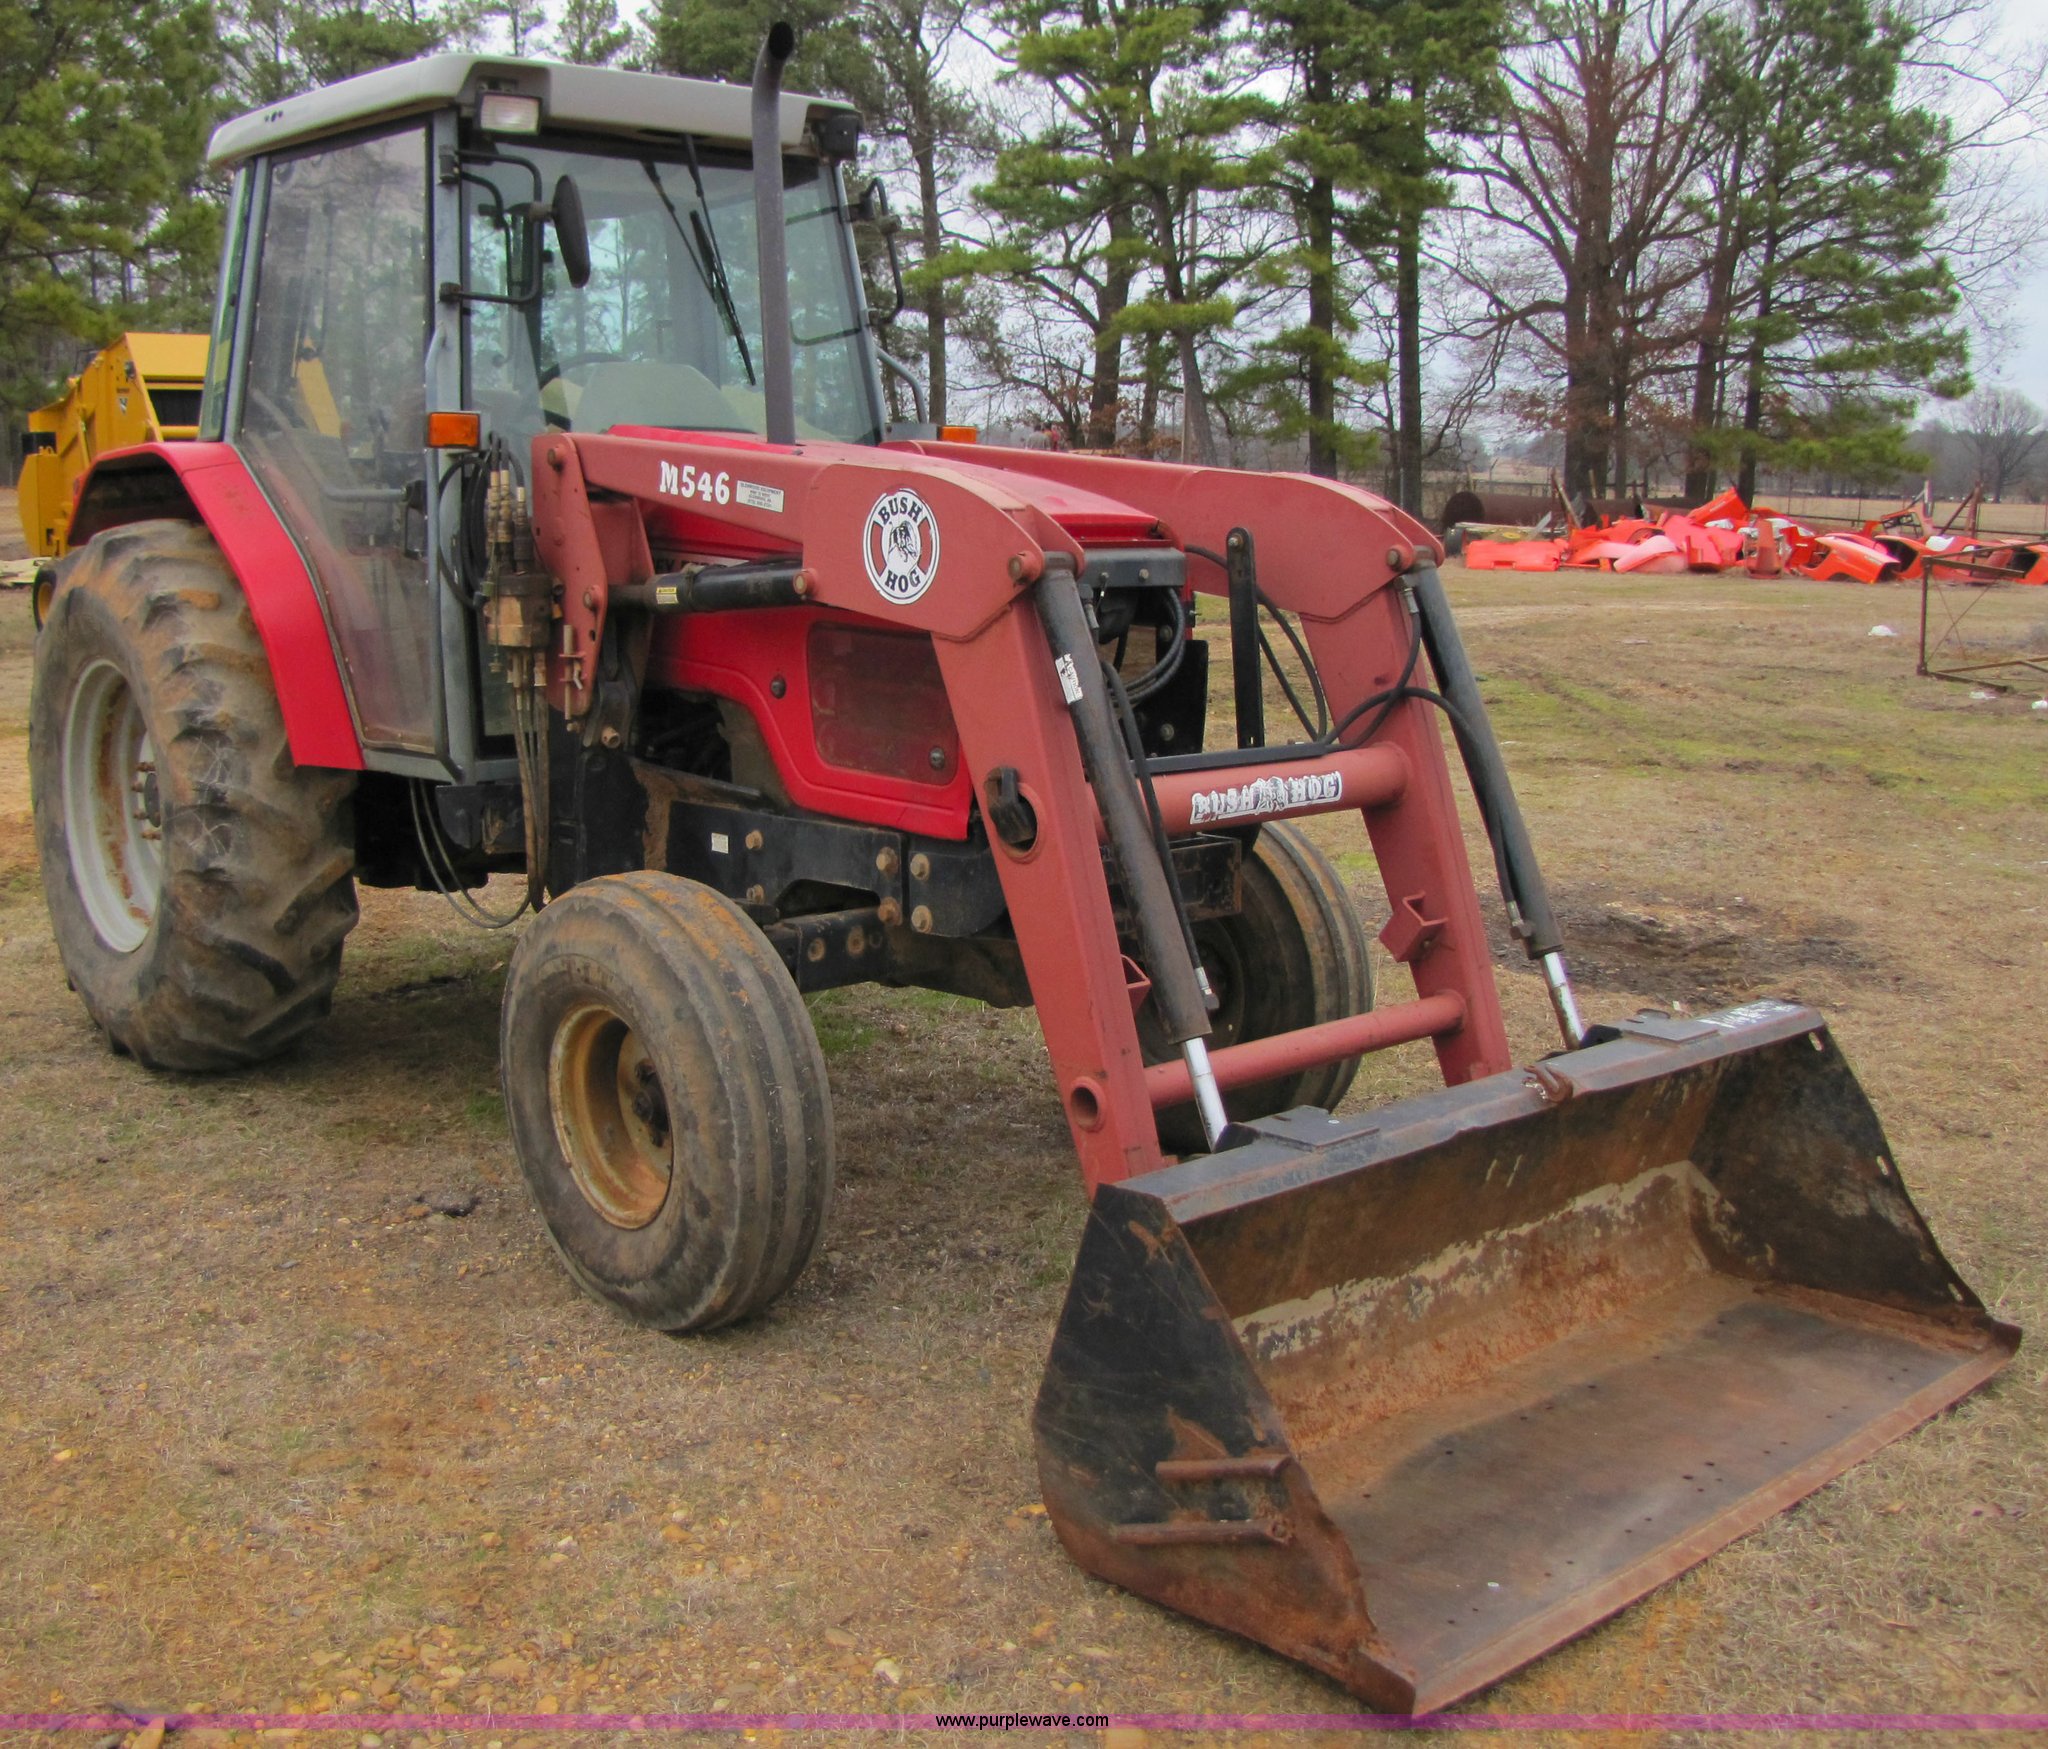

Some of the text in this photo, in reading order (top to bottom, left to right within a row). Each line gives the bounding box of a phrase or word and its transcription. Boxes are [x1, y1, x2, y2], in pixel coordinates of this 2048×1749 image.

[660, 460, 730, 505] M546
[878, 497, 922, 525] BUSH
[885, 568, 920, 593] HOG
[1194, 773, 1337, 818] BUSH HOG
